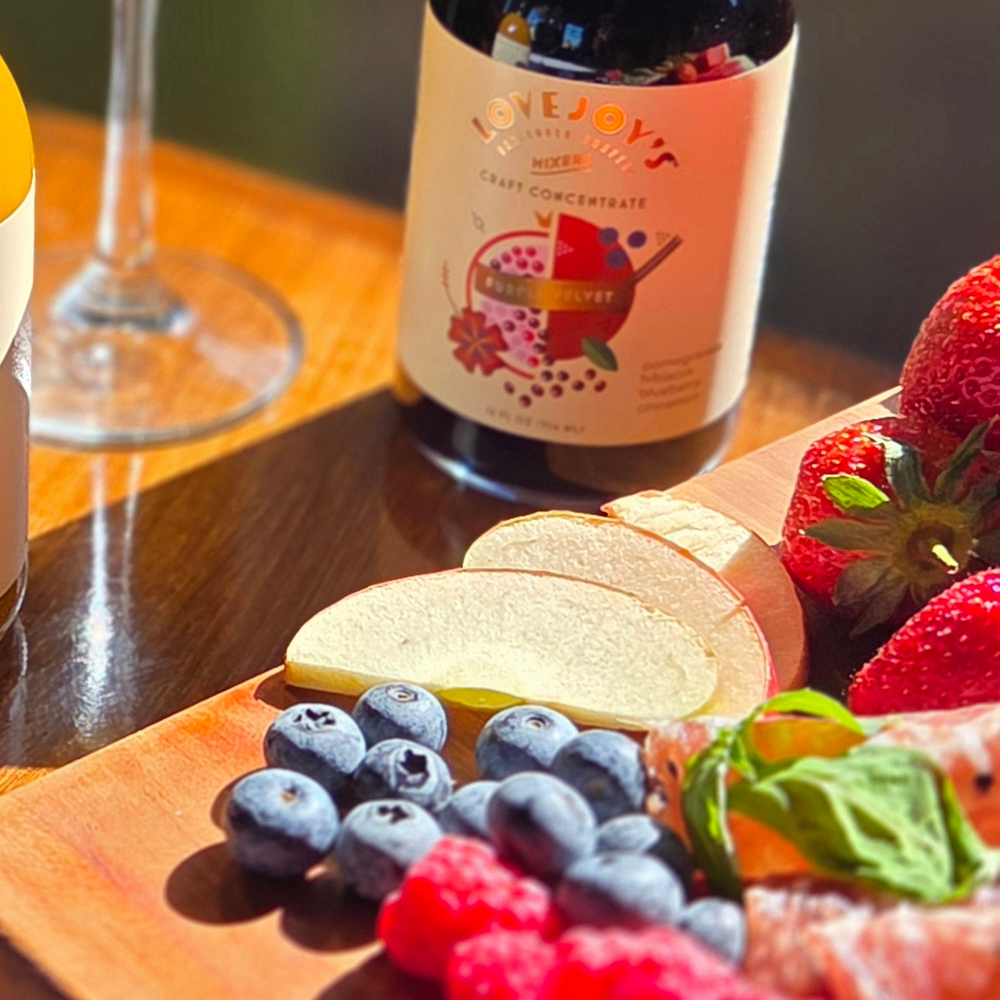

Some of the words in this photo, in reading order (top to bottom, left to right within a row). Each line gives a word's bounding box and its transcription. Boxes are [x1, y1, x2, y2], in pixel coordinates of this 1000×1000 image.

[471, 91, 679, 169] LOVEJOY'S
[479, 169, 523, 193] CRAFT
[529, 186, 648, 209] CONCENTRATE
